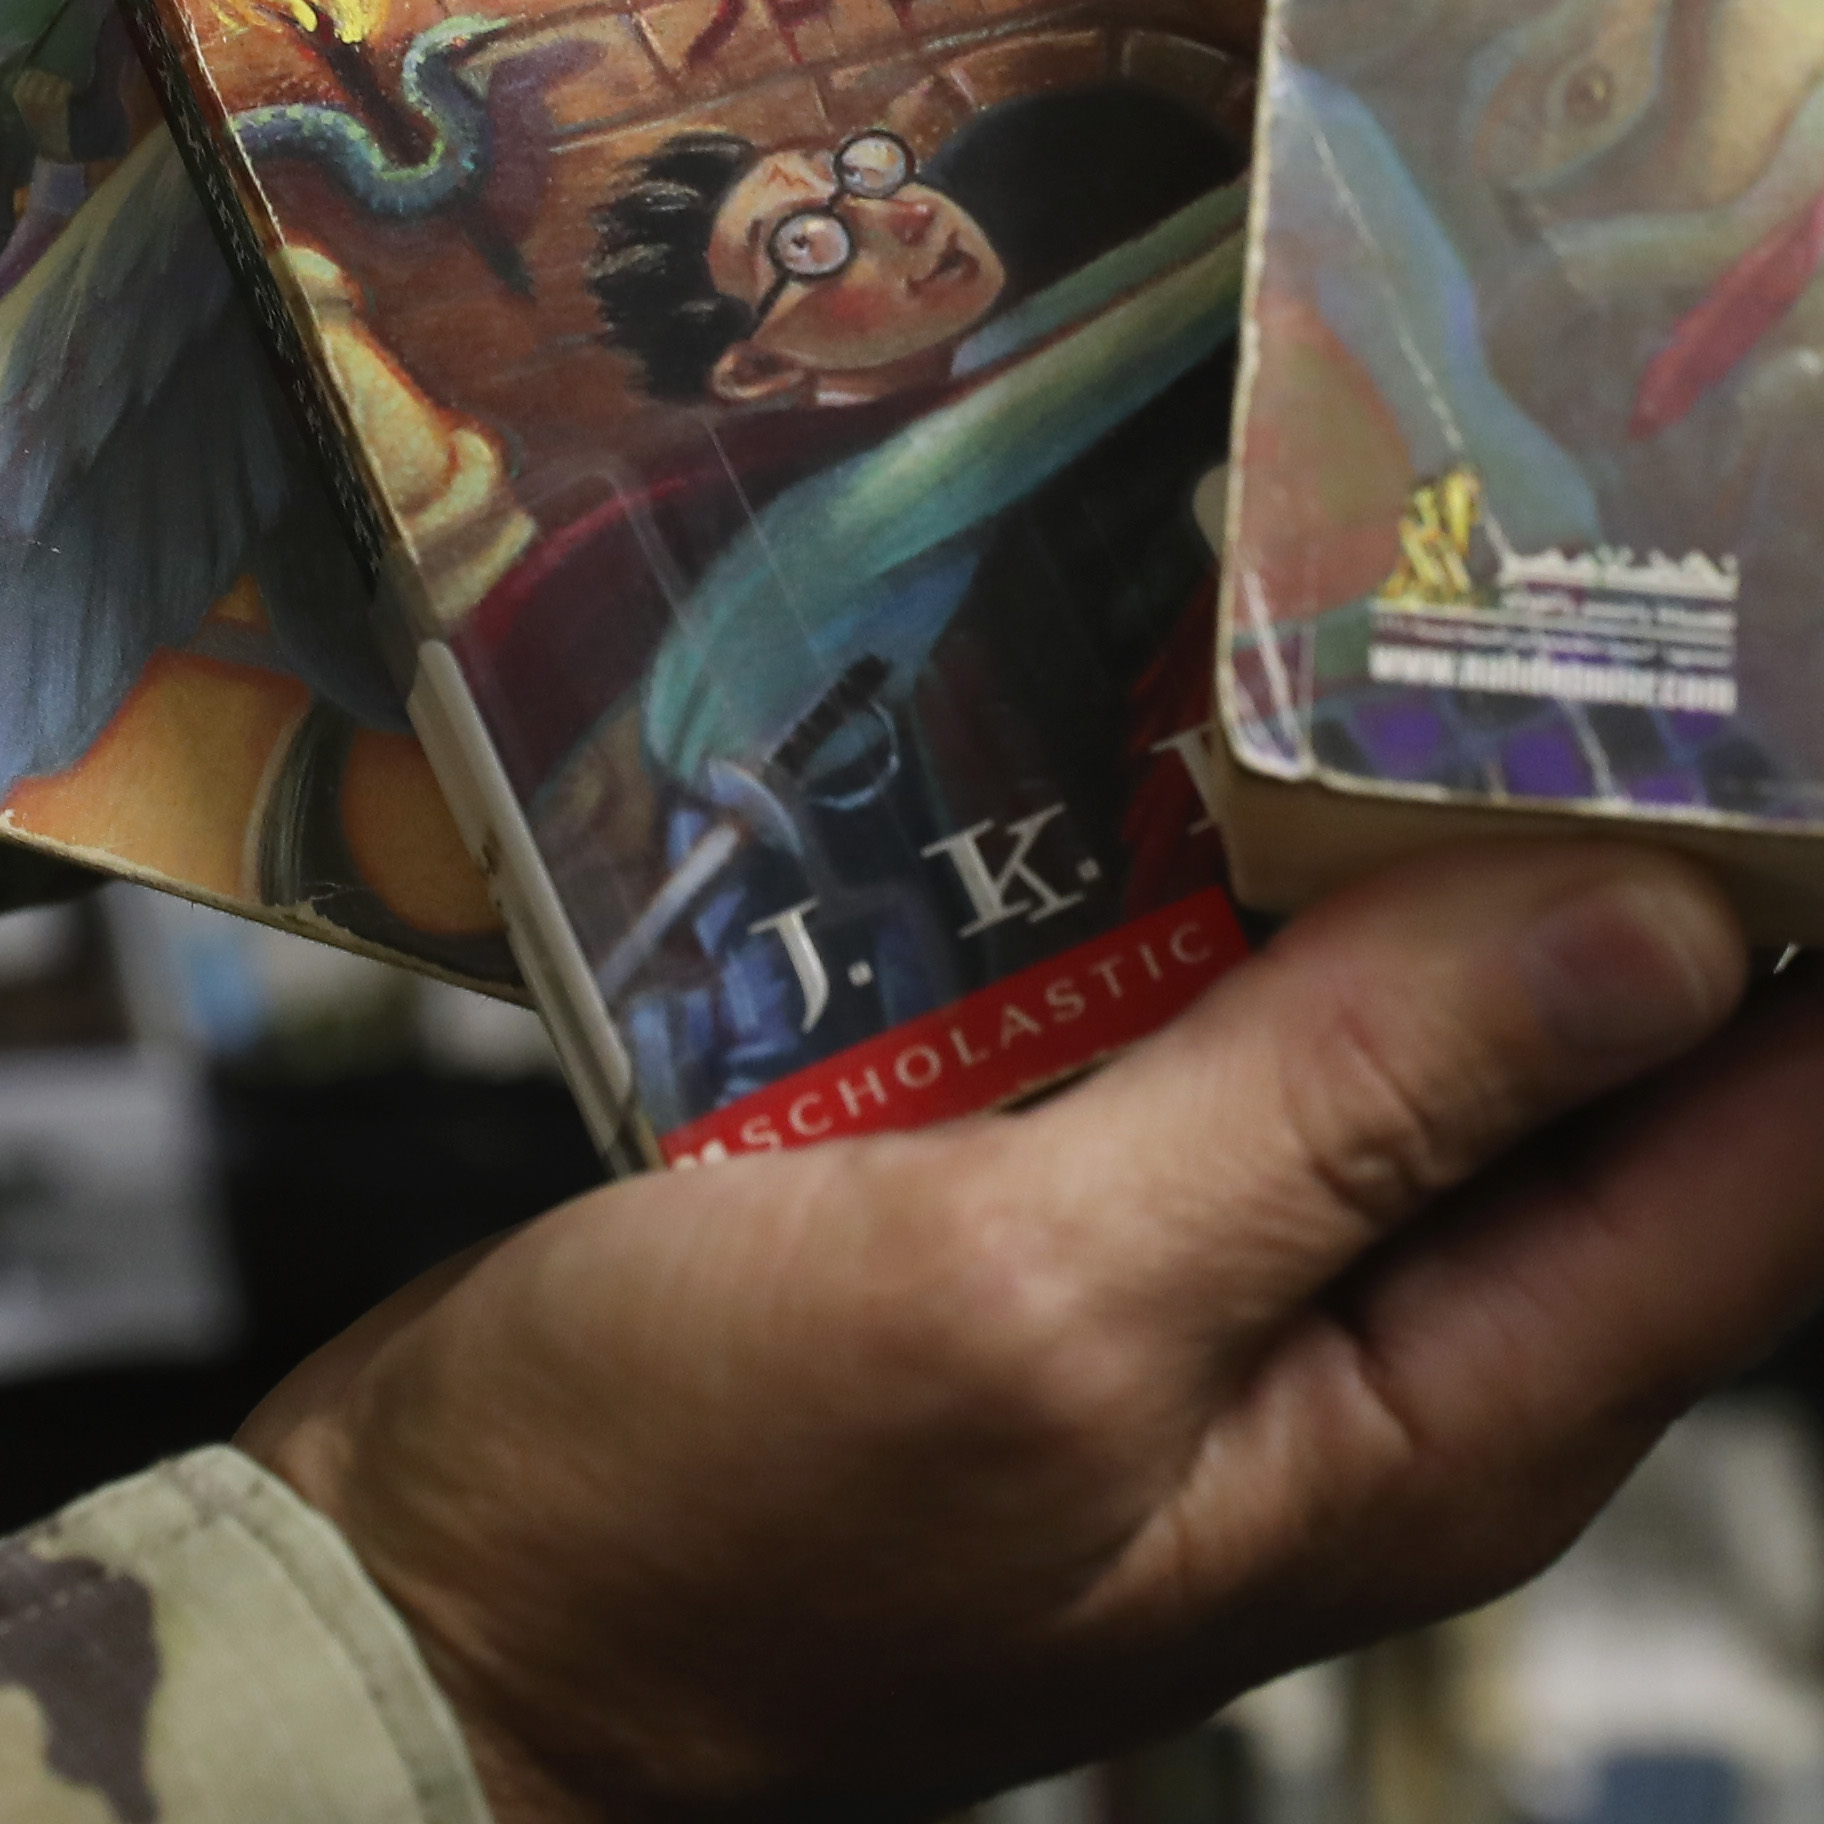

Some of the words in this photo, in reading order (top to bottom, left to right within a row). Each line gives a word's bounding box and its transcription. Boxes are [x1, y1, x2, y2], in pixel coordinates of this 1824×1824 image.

[748, 896, 872, 1033] J.
[919, 801, 1100, 938] K.
[740, 921, 1213, 1154] SCHOLASTIC
